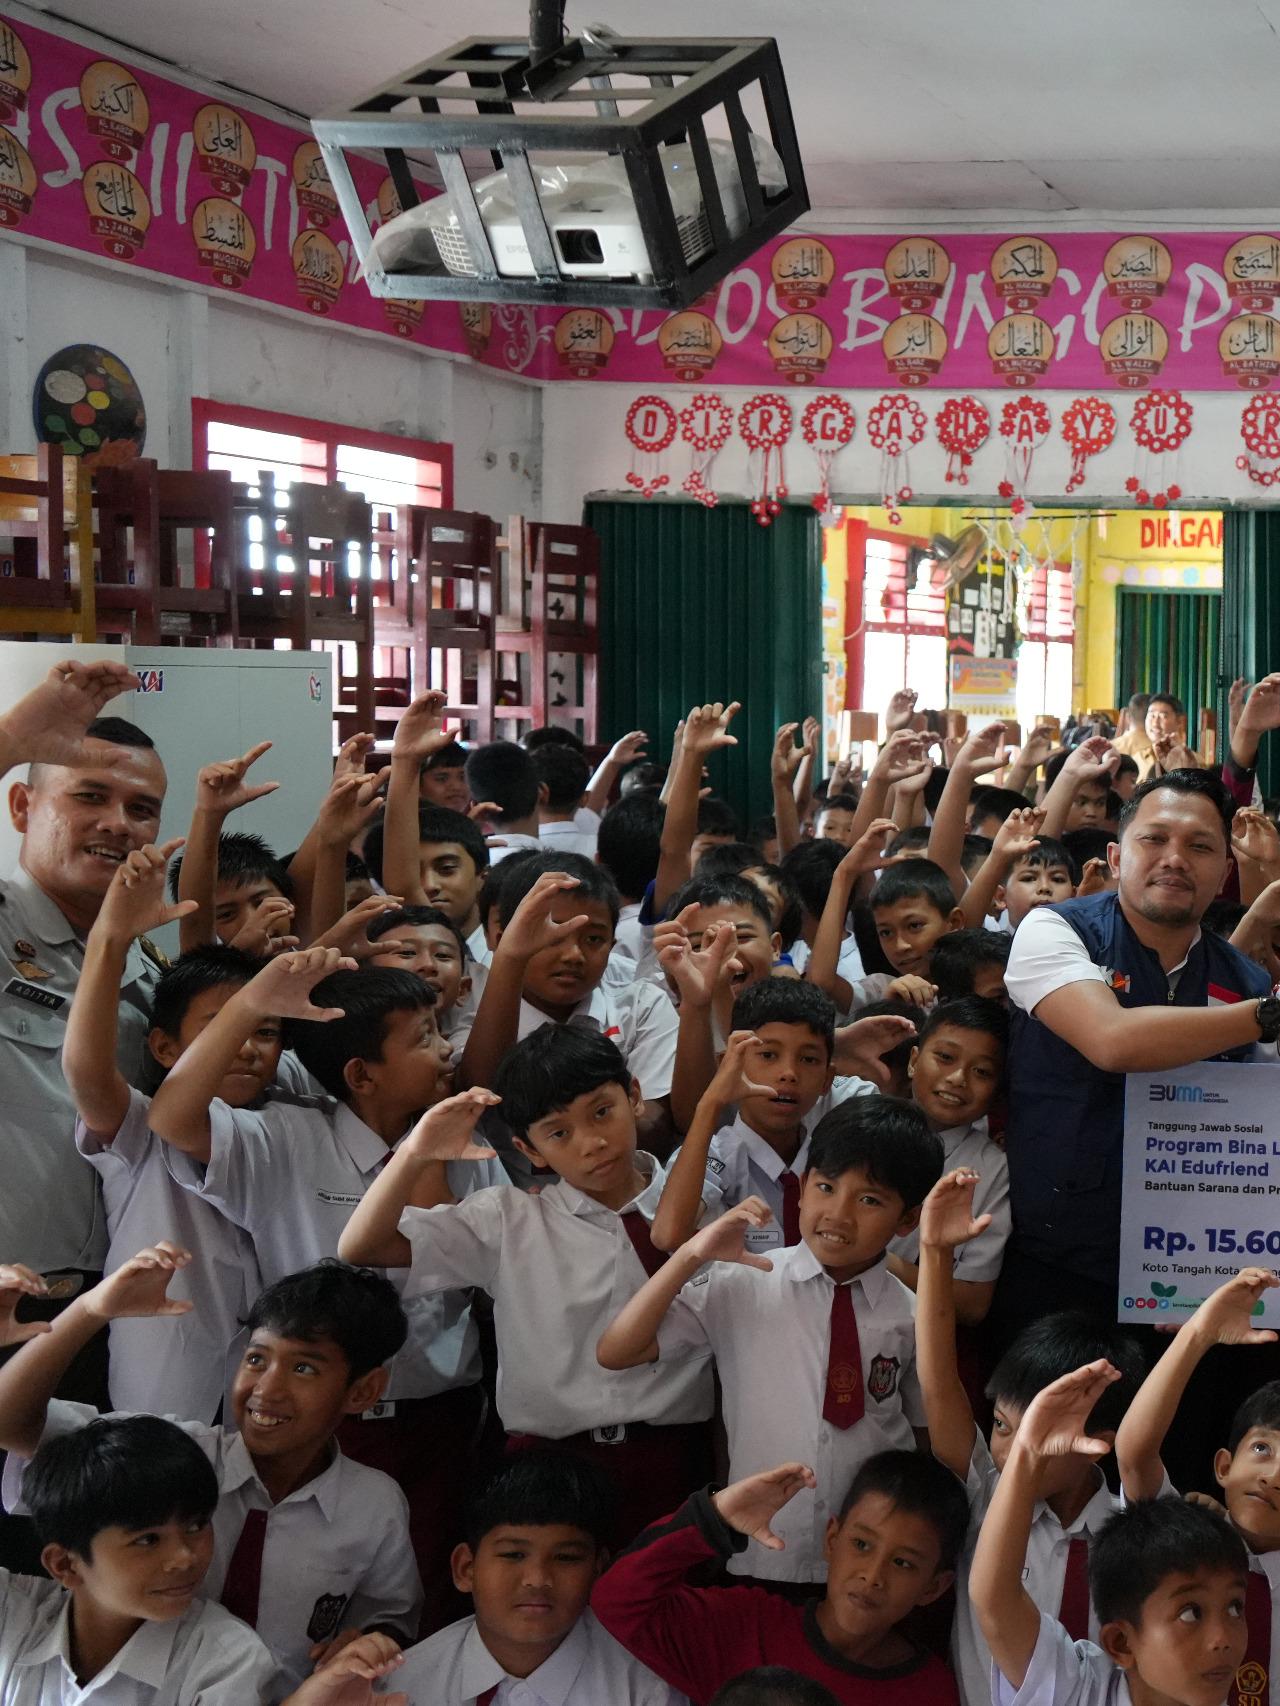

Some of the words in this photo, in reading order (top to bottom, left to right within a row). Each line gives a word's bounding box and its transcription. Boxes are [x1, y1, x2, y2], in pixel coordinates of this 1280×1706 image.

[1131, 299, 1142, 308] 27
[1251, 299, 1263, 308] 26
[1127, 376, 1138, 386] 77
[1248, 377, 1259, 386] 76
[137, 671, 163, 693] KAI
[1101, 965, 1131, 995] KAI
[15, 985, 56, 1007] ADITYA
[1148, 1121, 1197, 1133] Tanggung
[1199, 1123, 1232, 1133] Jawab
[1234, 1124, 1263, 1134] Sosial
[1145, 1137, 1223, 1156] Program
[1228, 1139, 1267, 1155] Bina
[1145, 1159, 1176, 1174] KAI
[1182, 1159, 1269, 1177] Edufriend
[1144, 1180, 1195, 1192] Bantuan
[1198, 1182, 1239, 1194] Sarana
[1242, 1183, 1265, 1195] dan
[1144, 1226, 1196, 1256] Rp.
[1142, 1263, 1169, 1273] Koto
[1172, 1264, 1211, 1276] Tangah
[1214, 1265, 1240, 1275] Kota
